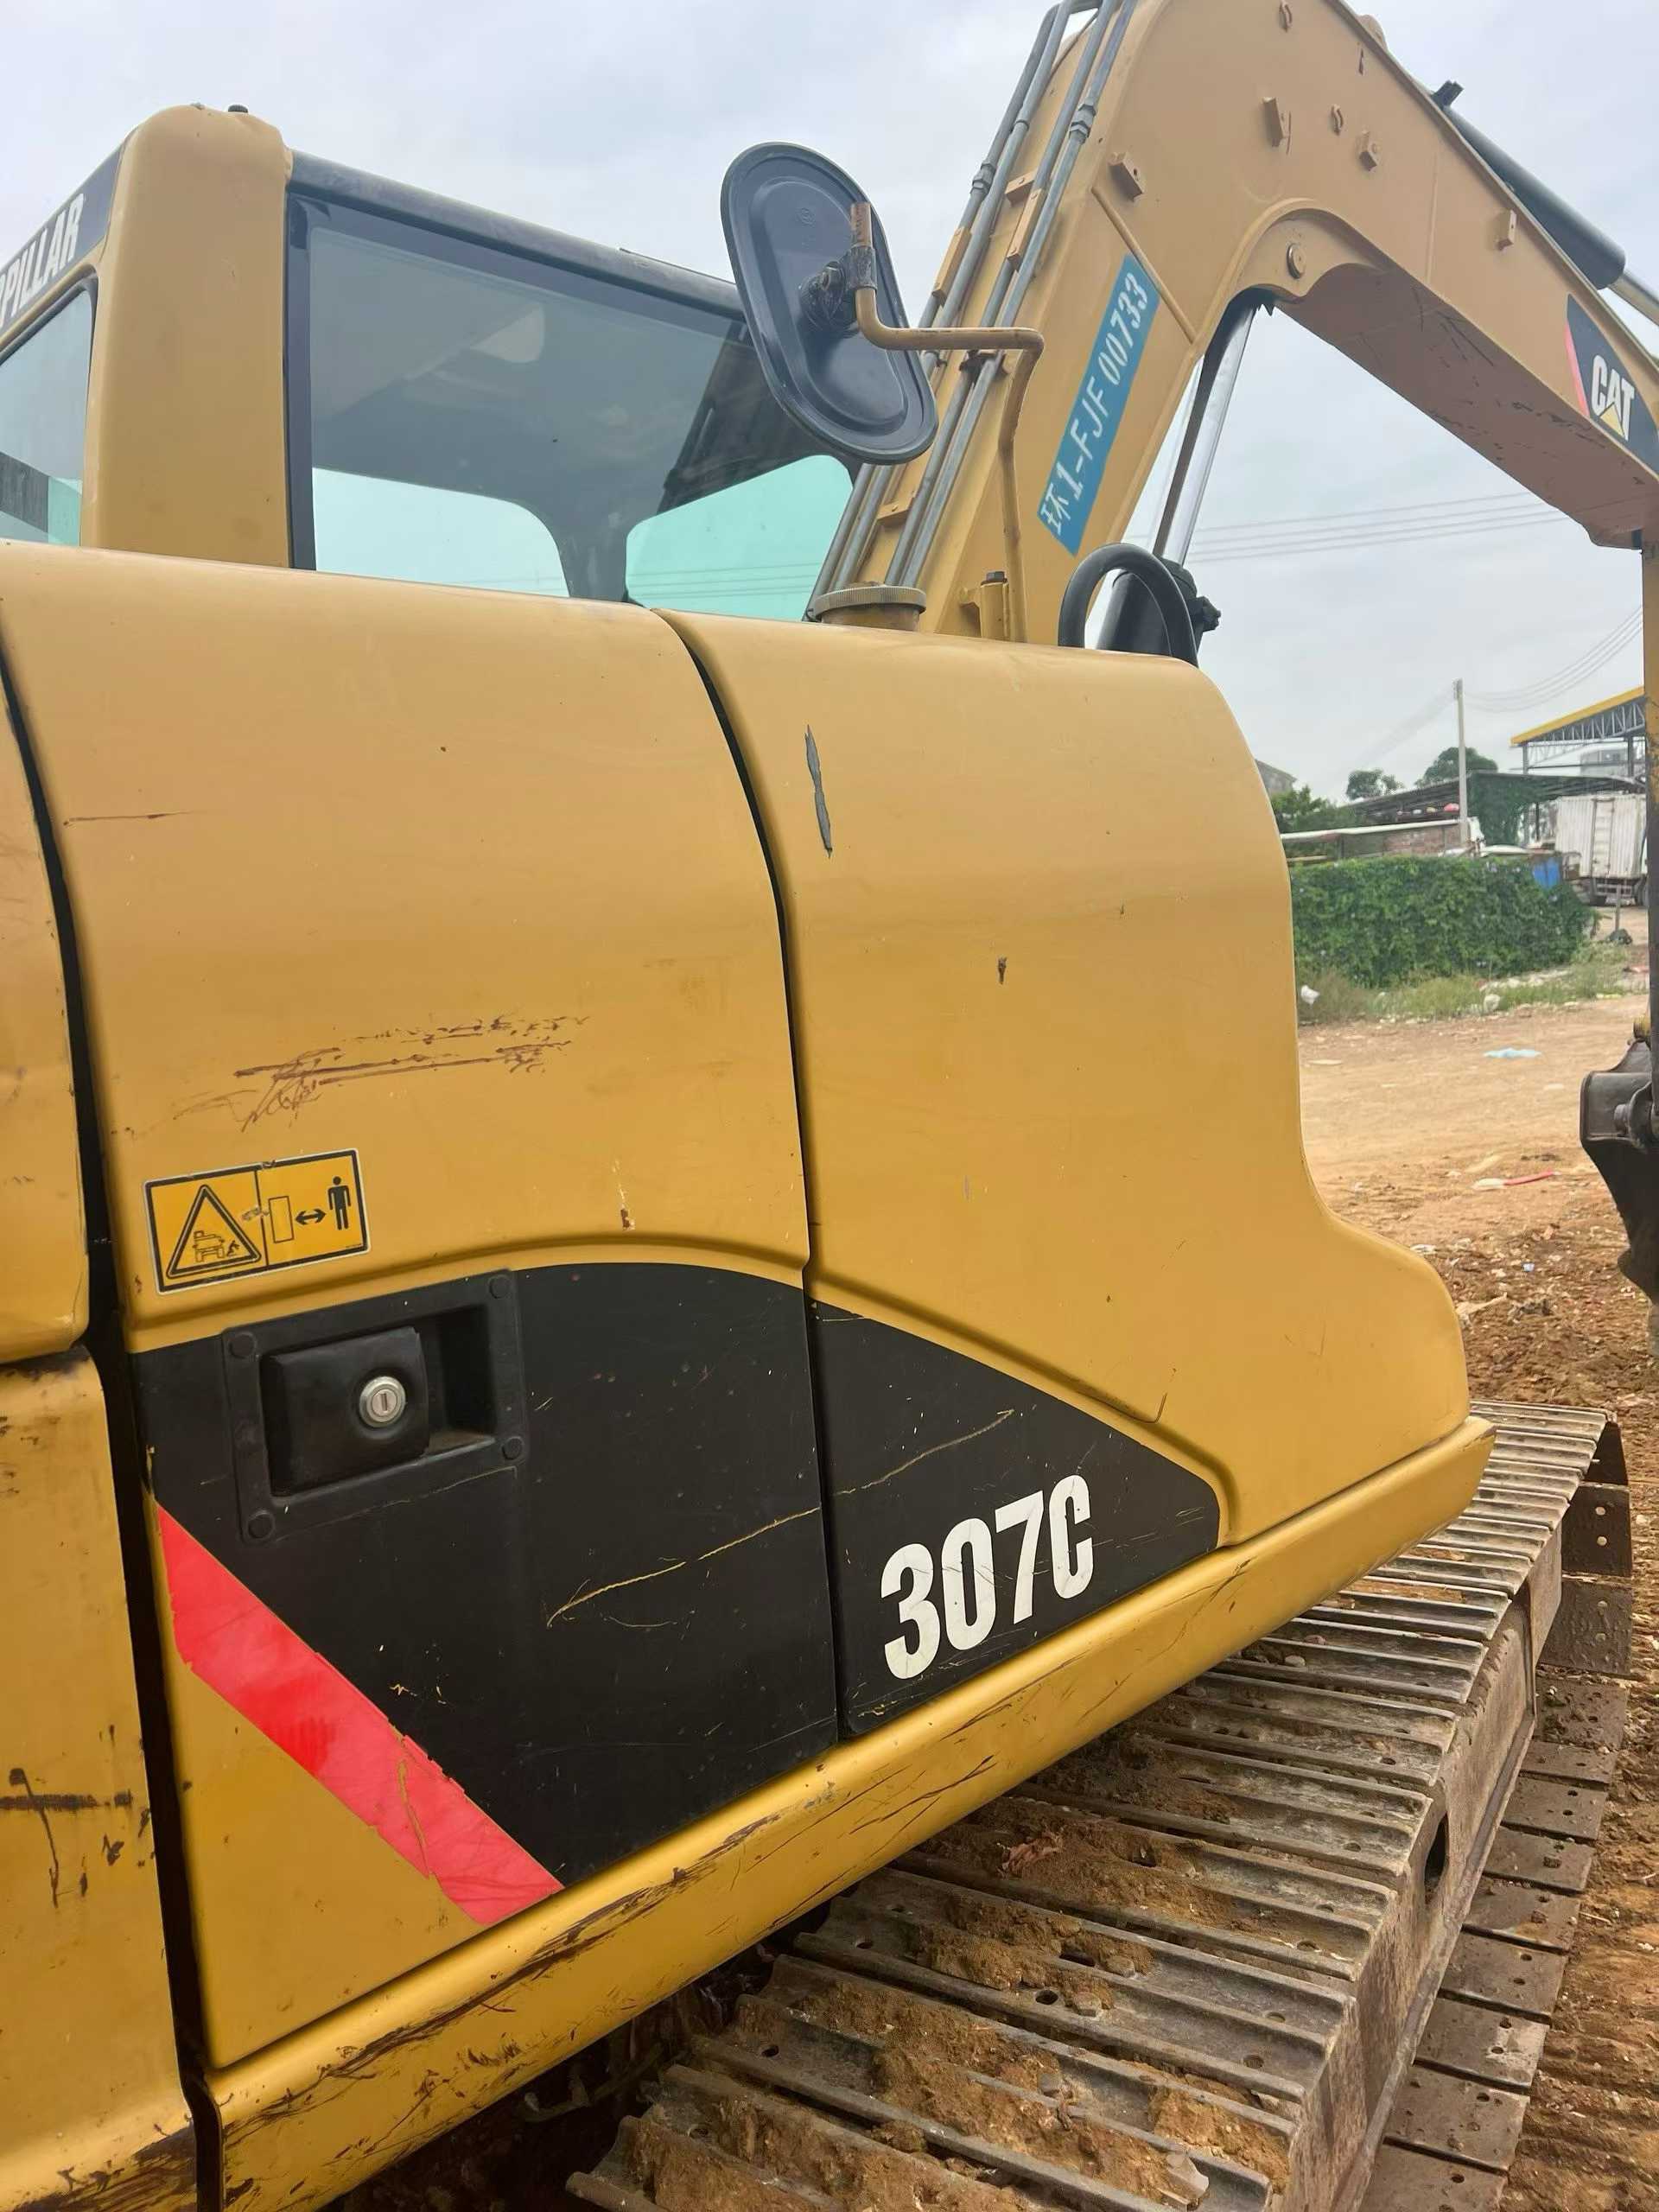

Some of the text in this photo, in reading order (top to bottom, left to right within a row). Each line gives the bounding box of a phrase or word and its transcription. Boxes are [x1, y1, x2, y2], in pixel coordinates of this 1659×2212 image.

[0, 193, 85, 327] PILLAR
[1098, 272, 1147, 385] 00733
[1591, 354, 1635, 441] CAT
[881, 1474, 1094, 1679] 307C
